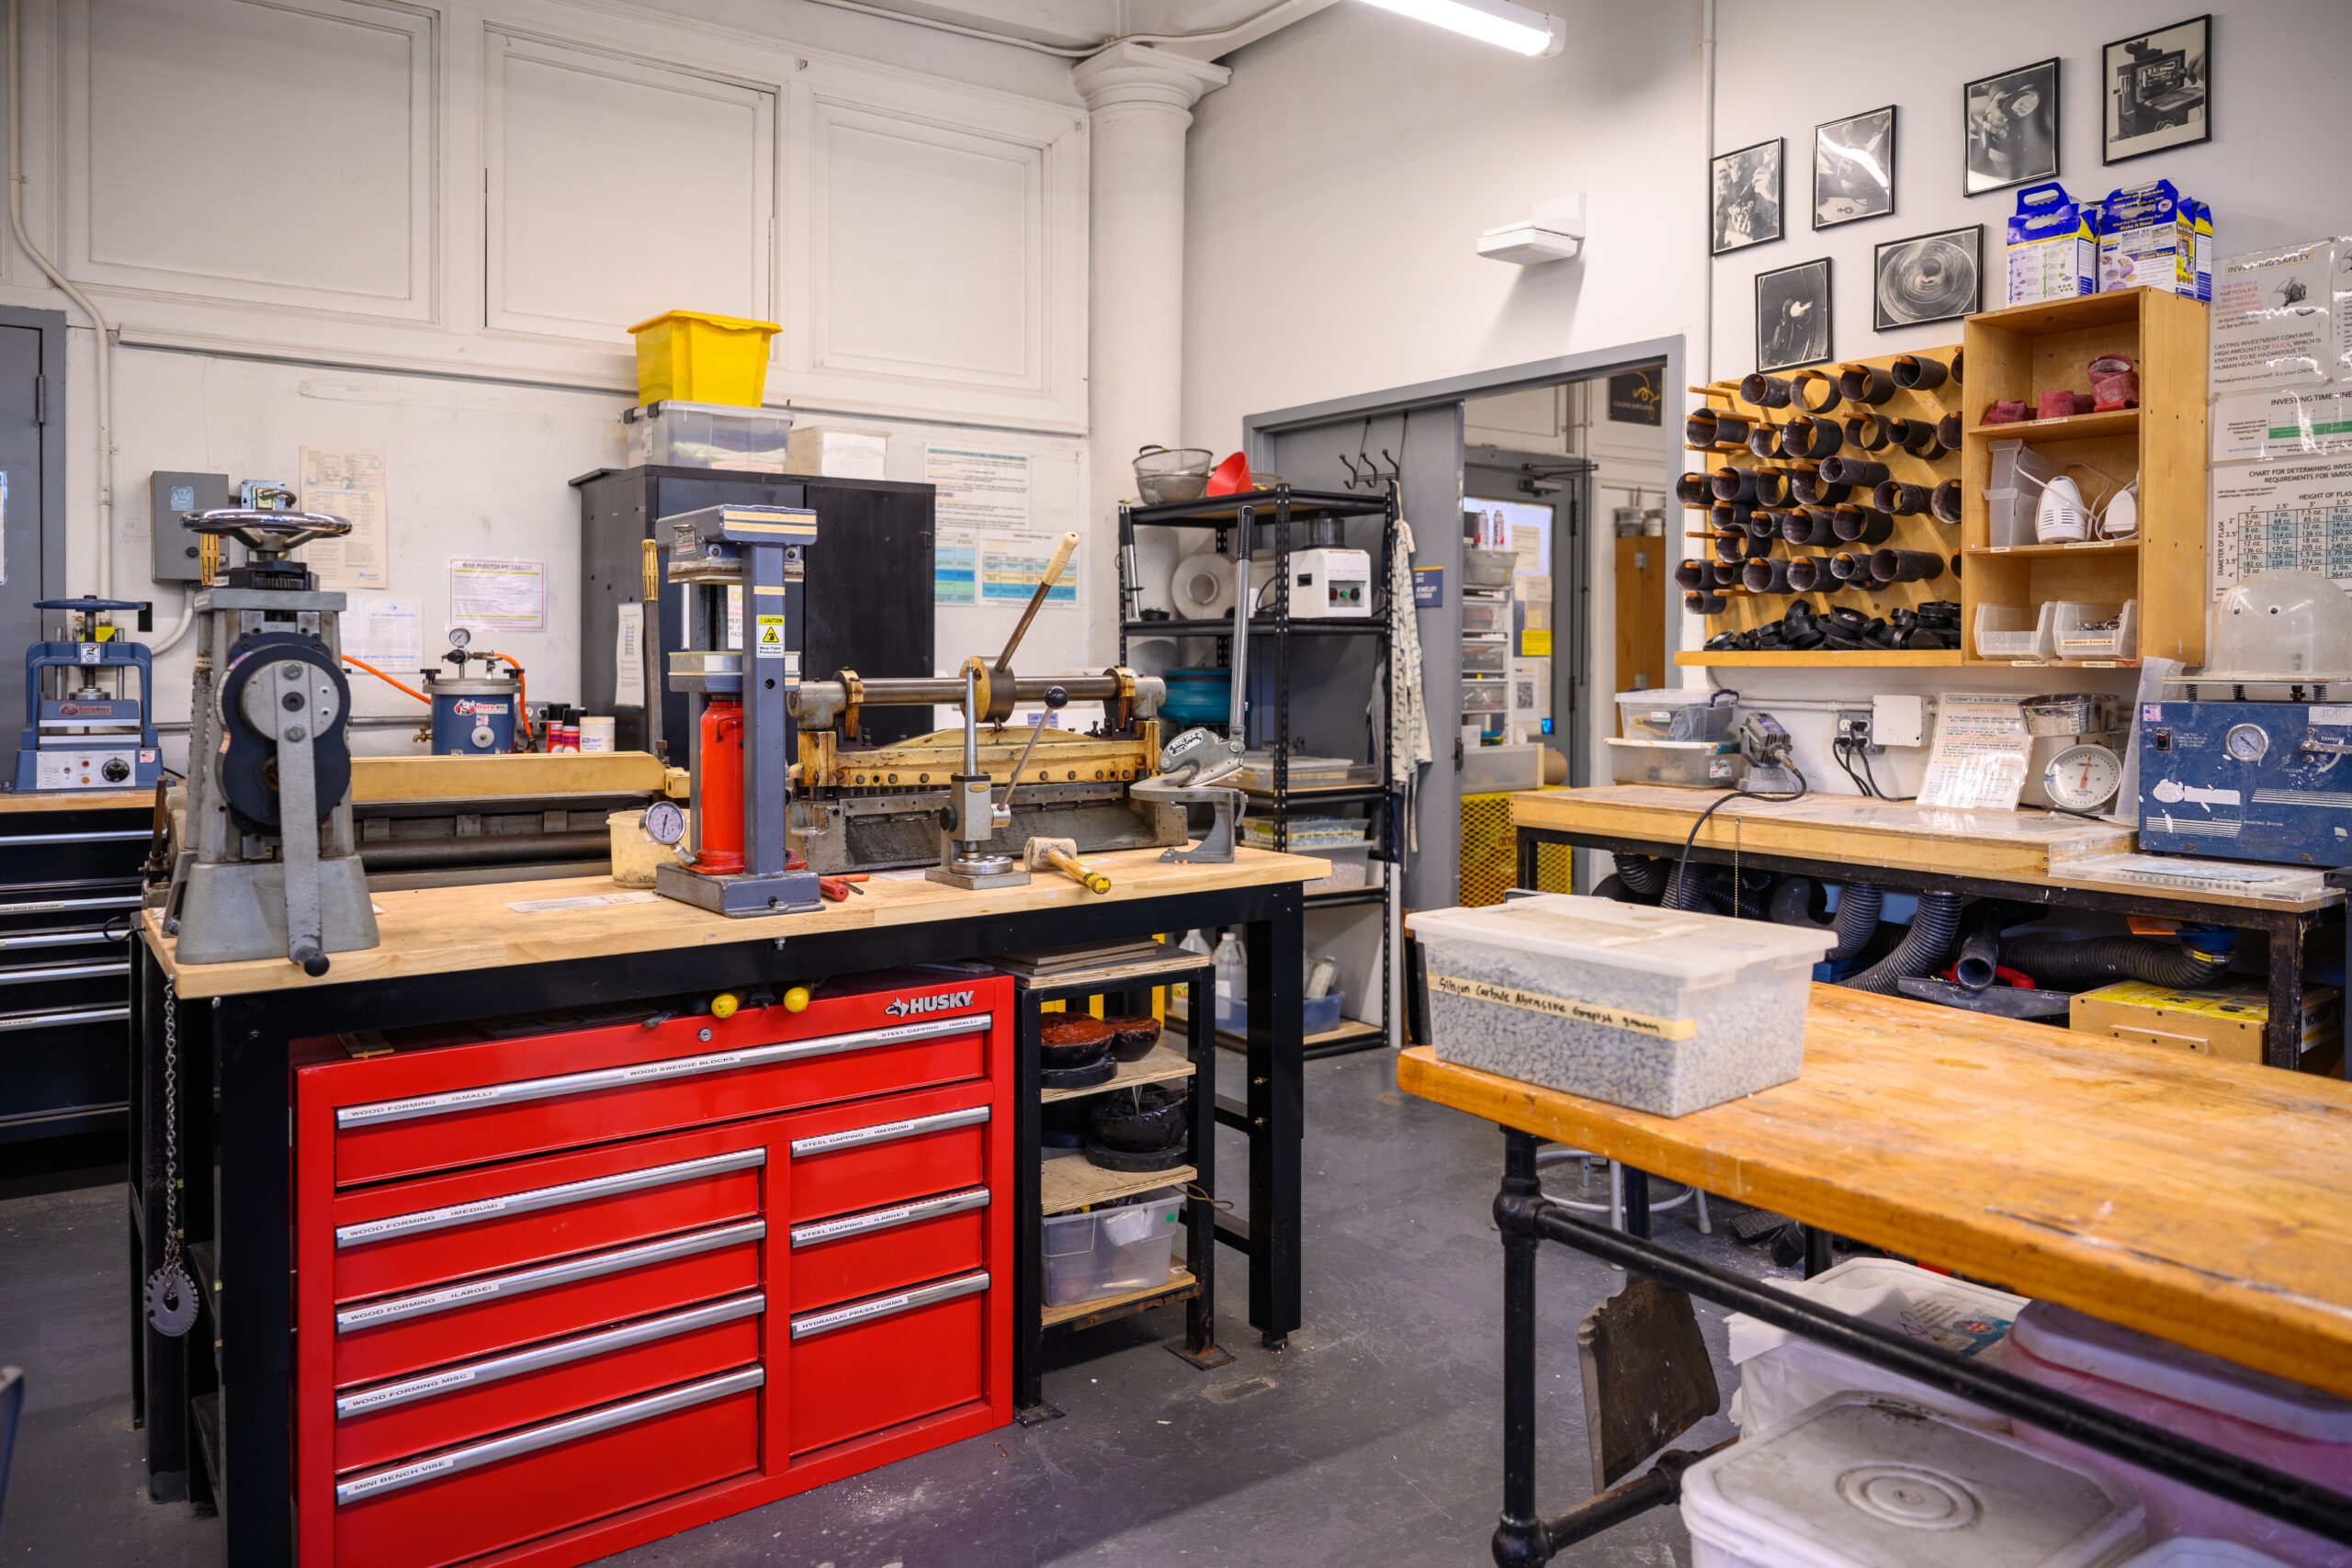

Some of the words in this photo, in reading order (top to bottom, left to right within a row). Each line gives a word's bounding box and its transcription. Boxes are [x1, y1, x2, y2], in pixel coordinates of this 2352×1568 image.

[2228, 262, 2275, 273] INVESING
[2277, 254, 2311, 265] SAFETY
[2242, 336, 2279, 345] INVESTMENT
[2281, 332, 2313, 340] CONTAINS
[2257, 347, 2296, 357] HAZARDOUS
[2271, 396, 2312, 405] INVESTNG
[2265, 474, 2313, 483] REQUIREMENTS
[2288, 465, 2330, 474] DETERMINING
[2218, 539, 2223, 547] OF
[910, 991, 974, 1014] HUSKY
[908, 1025, 939, 1033] DAPPING
[949, 1020, 977, 1028] (SMALL)
[660, 1063, 696, 1071] SWEDGE
[699, 1057, 734, 1066] BLOCKS
[352, 1107, 384, 1116] WOOD
[388, 1100, 435, 1111] FORMING
[452, 1091, 492, 1101] (SMALL)
[830, 1134, 864, 1143] DAPPING
[875, 1125, 909, 1134] (MEDIUM)
[350, 1225, 383, 1236] WOOD
[387, 1215, 435, 1229] FORMING
[451, 1203, 498, 1216] (MEDIUM)
[802, 1230, 828, 1238] STEEL
[830, 1222, 863, 1232] DAPPING
[875, 1213, 904, 1222] (LARGE)
[351, 1309, 384, 1320] WOOD
[388, 1298, 435, 1313] FORMING
[451, 1286, 492, 1298] (LARGE)
[802, 1314, 846, 1328] HYDRAULIC
[850, 1307, 875, 1316] PRESS
[876, 1299, 902, 1310] FORMS
[353, 1395, 386, 1406] WOOD
[390, 1382, 438, 1396] FORMING
[442, 1373, 468, 1384] MISC
[355, 1480, 377, 1490] MINI
[380, 1469, 418, 1483] BENCH
[422, 1461, 446, 1471] VISE
